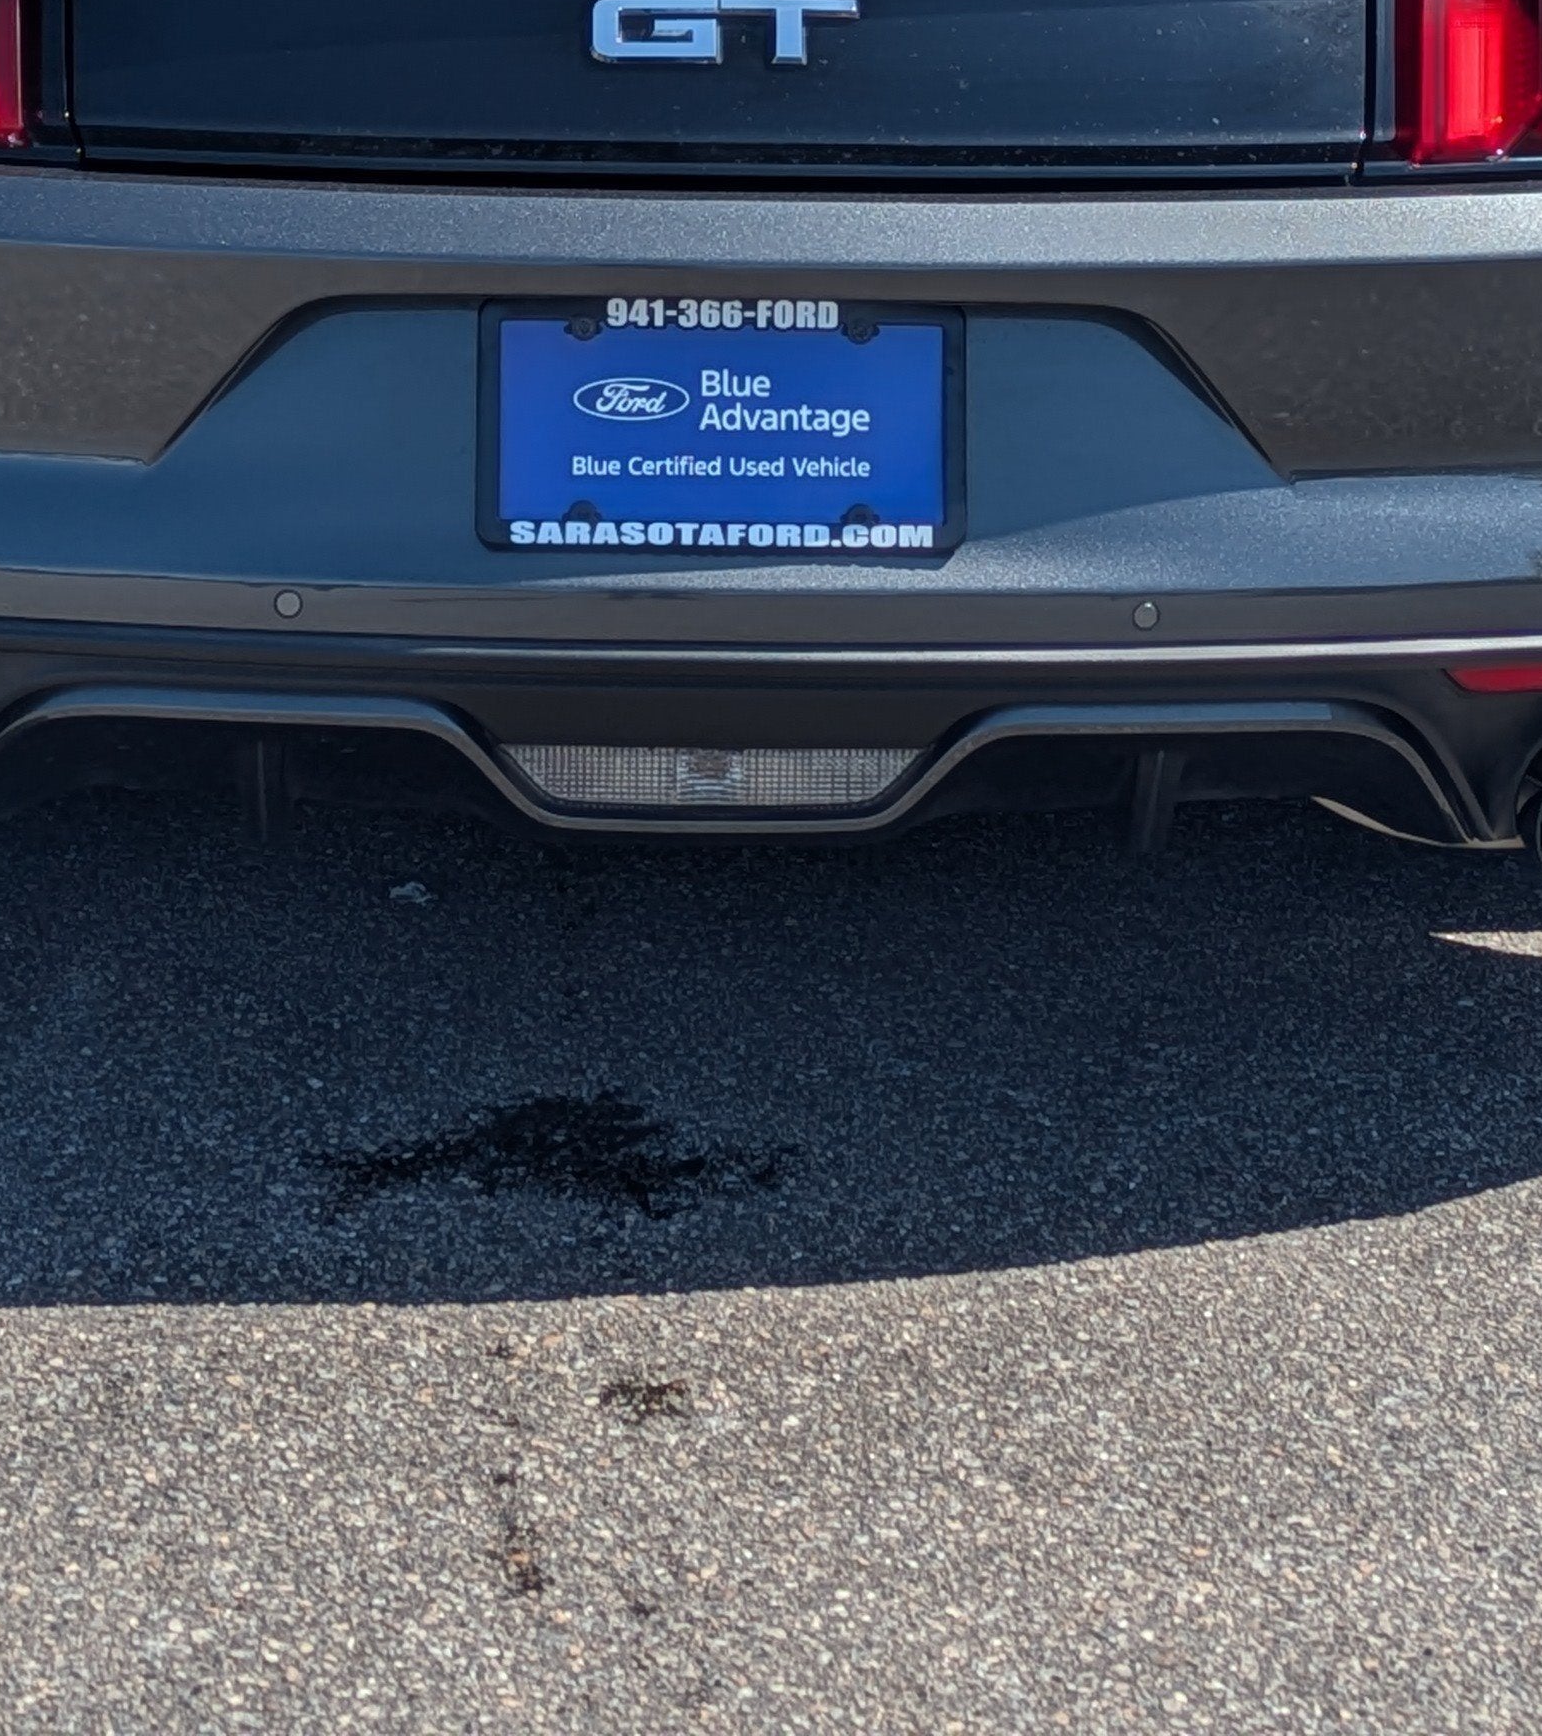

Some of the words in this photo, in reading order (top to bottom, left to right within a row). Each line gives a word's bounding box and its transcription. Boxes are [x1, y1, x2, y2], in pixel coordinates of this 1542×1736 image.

[606, 297, 839, 329] 941-366-FORD
[700, 369, 771, 397] Blue
[595, 383, 666, 415] Ford
[699, 403, 871, 437] Advantage
[572, 456, 621, 475] Blue
[628, 455, 721, 476] Certified
[729, 457, 784, 477] Used
[792, 457, 871, 477] Vehicle
[509, 521, 934, 548] SARASOTAFORD.COM
